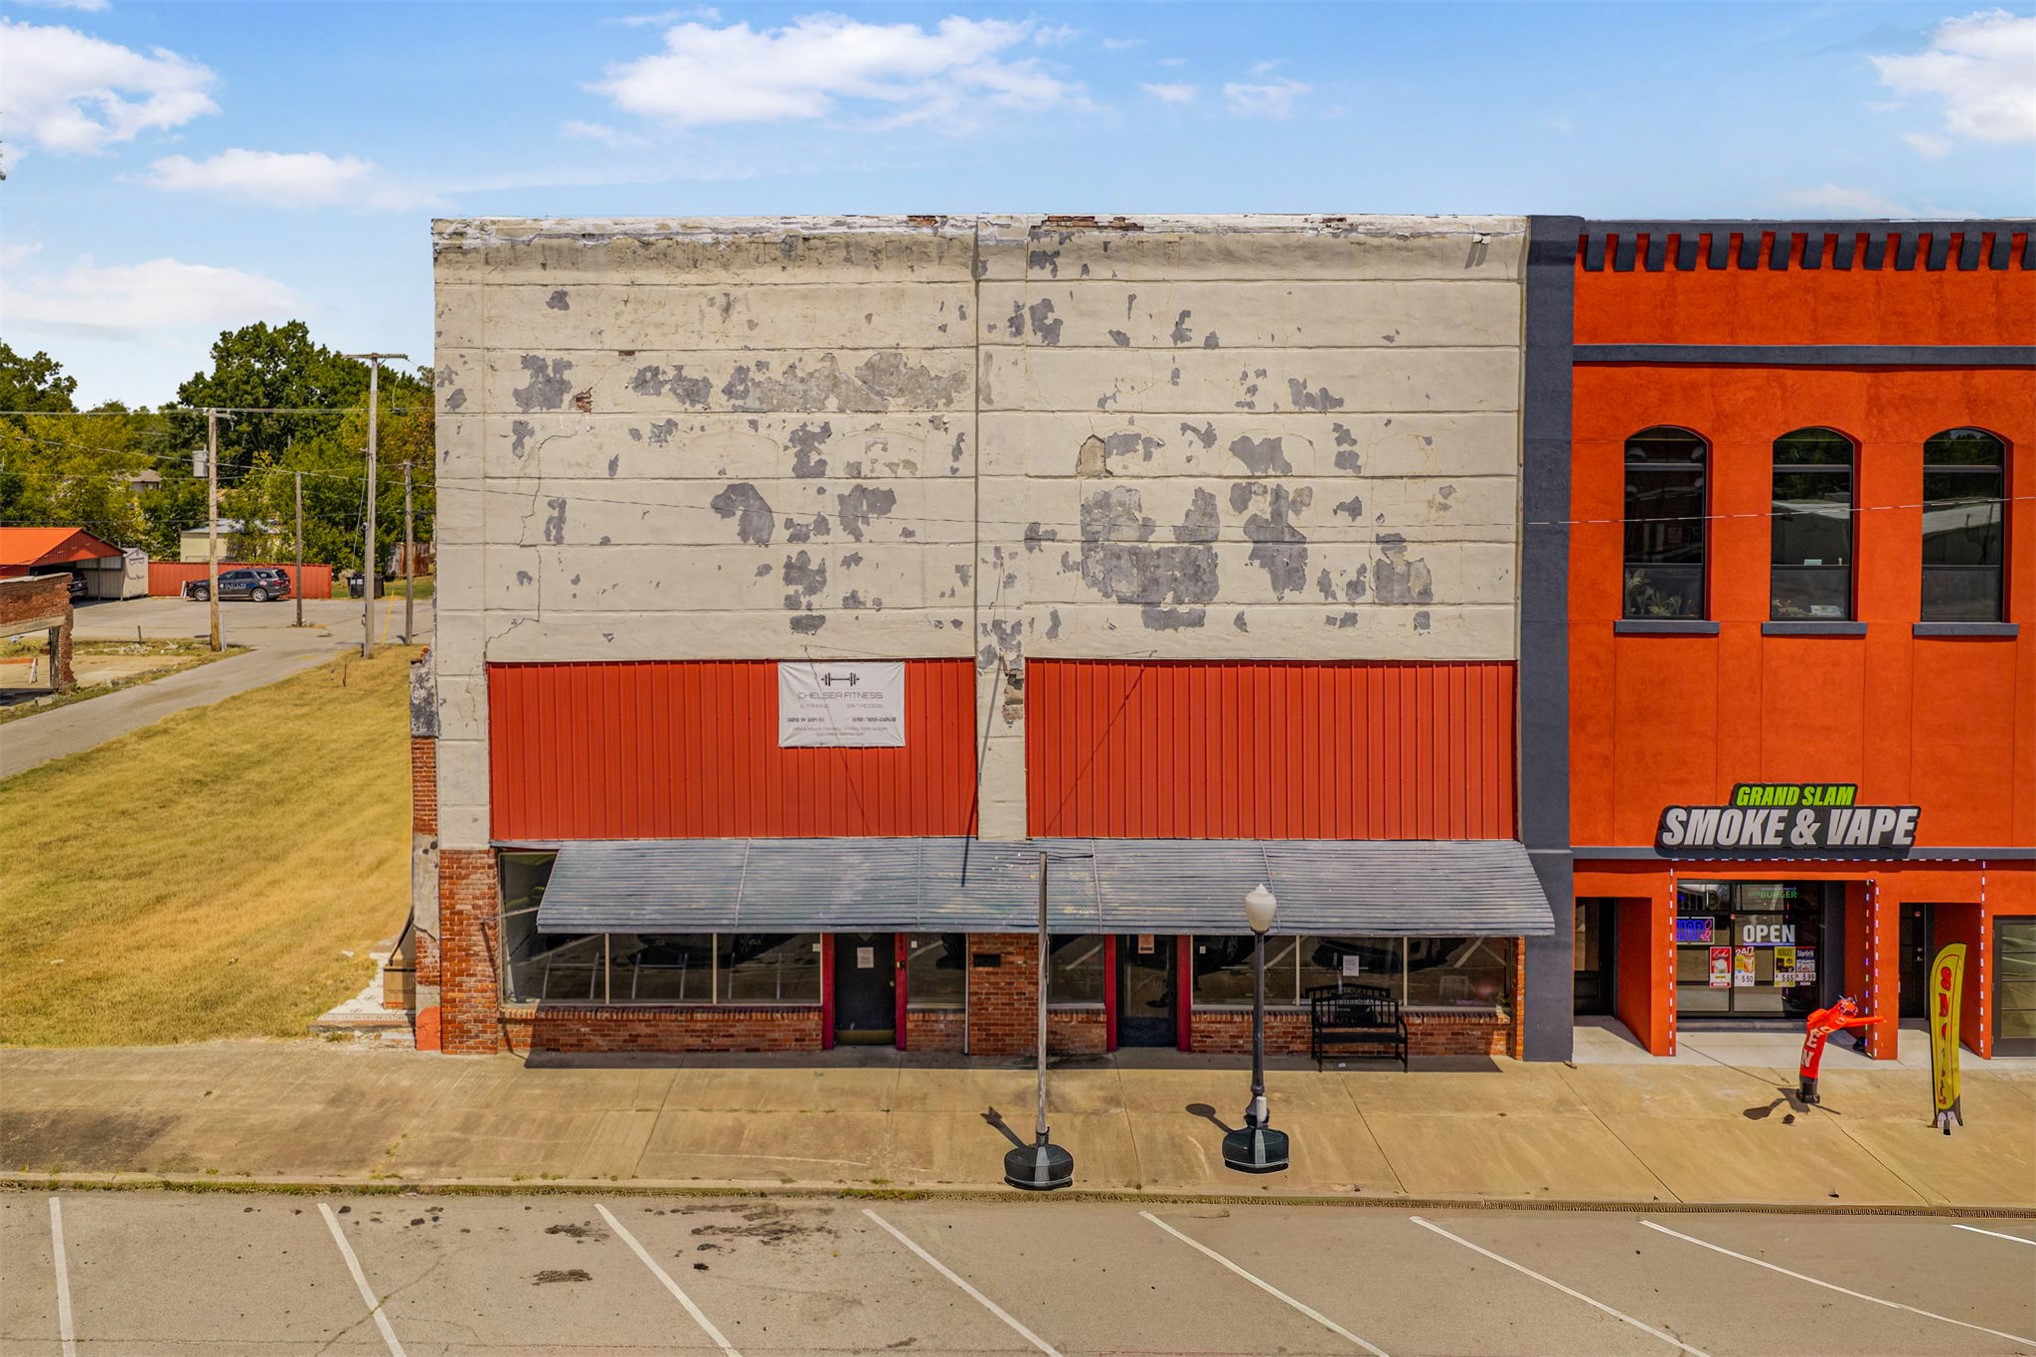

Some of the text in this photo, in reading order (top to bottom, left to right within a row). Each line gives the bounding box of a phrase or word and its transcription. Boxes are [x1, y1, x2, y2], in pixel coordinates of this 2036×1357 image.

[797, 691, 884, 700] CHELSEA FITNESS
[1737, 786, 1855, 806] GRAND SLAM
[1662, 808, 1919, 847] SMOKE & VAPE
[1760, 890, 1798, 899] BURGER
[1742, 924, 1796, 943] OPEN
